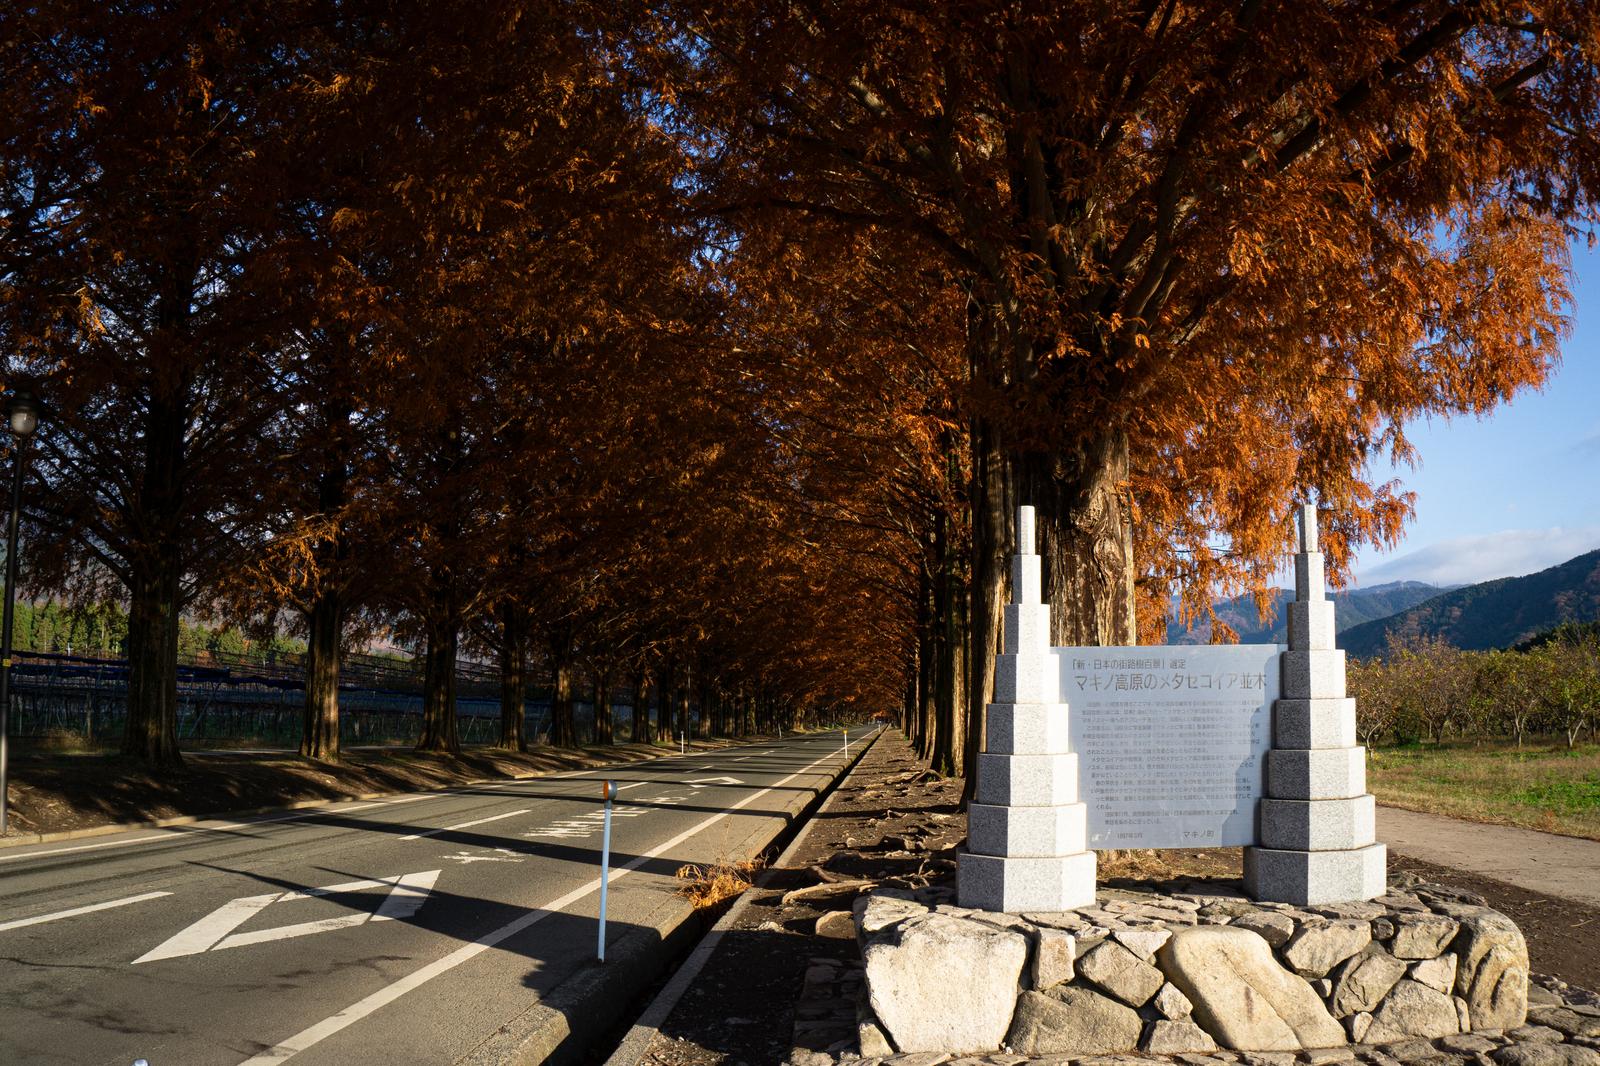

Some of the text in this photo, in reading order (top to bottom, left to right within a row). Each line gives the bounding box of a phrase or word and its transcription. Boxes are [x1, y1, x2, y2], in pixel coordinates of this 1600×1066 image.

[1074, 672, 1267, 692] マキノ高原のメタセコイア並木
